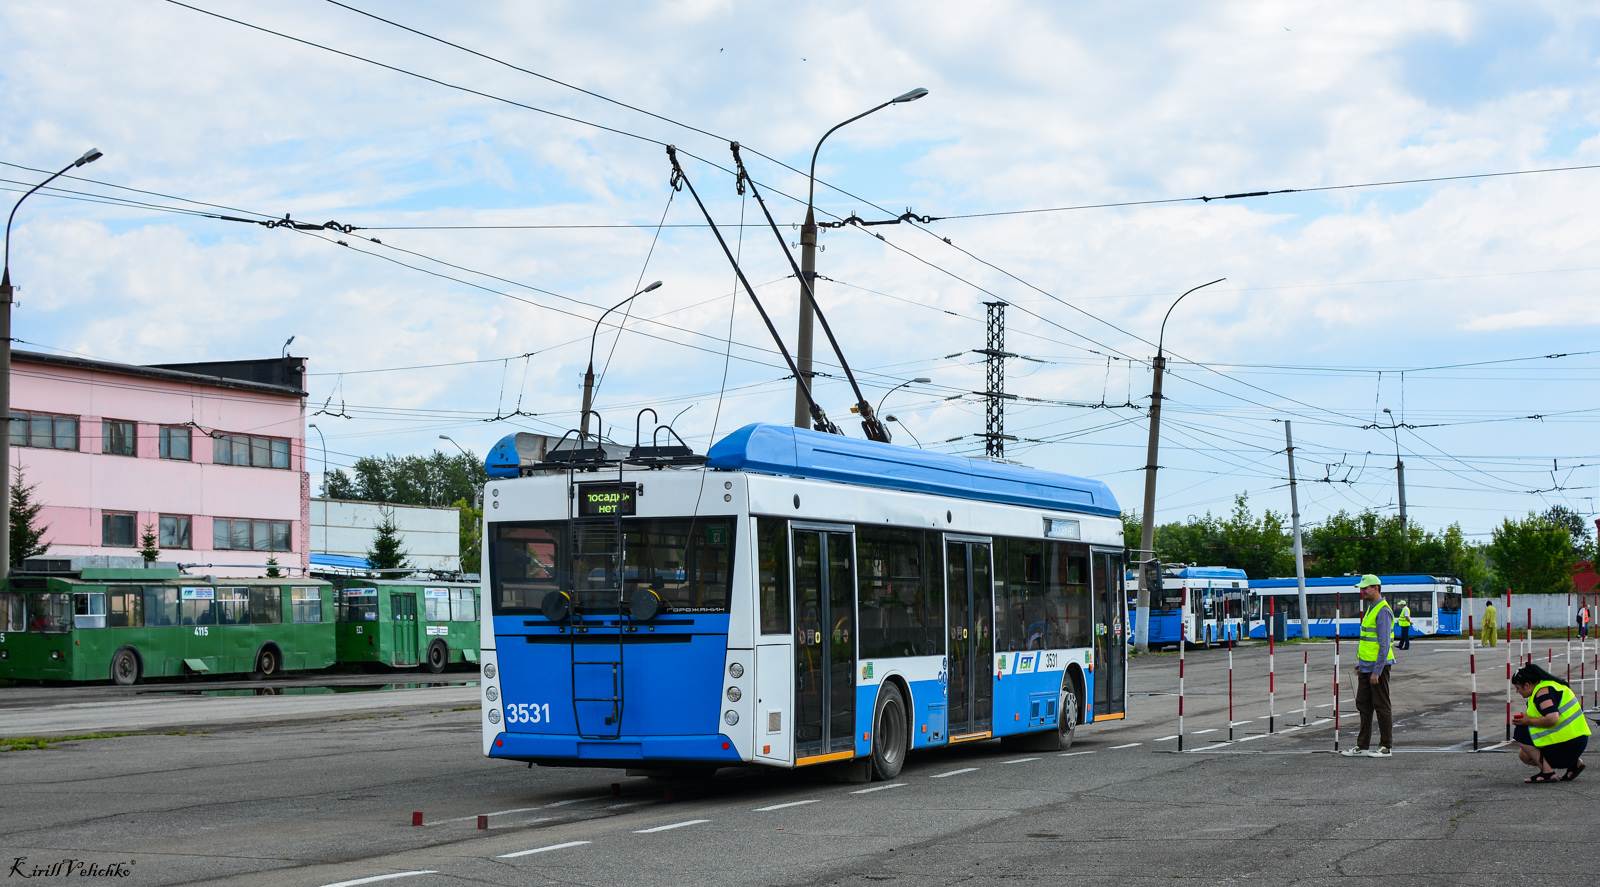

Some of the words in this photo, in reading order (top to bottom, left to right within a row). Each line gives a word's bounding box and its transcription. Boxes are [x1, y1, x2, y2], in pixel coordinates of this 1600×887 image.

[194, 626, 209, 636] 4115
[1046, 653, 1058, 668] 3531
[507, 703, 550, 723] 3531
